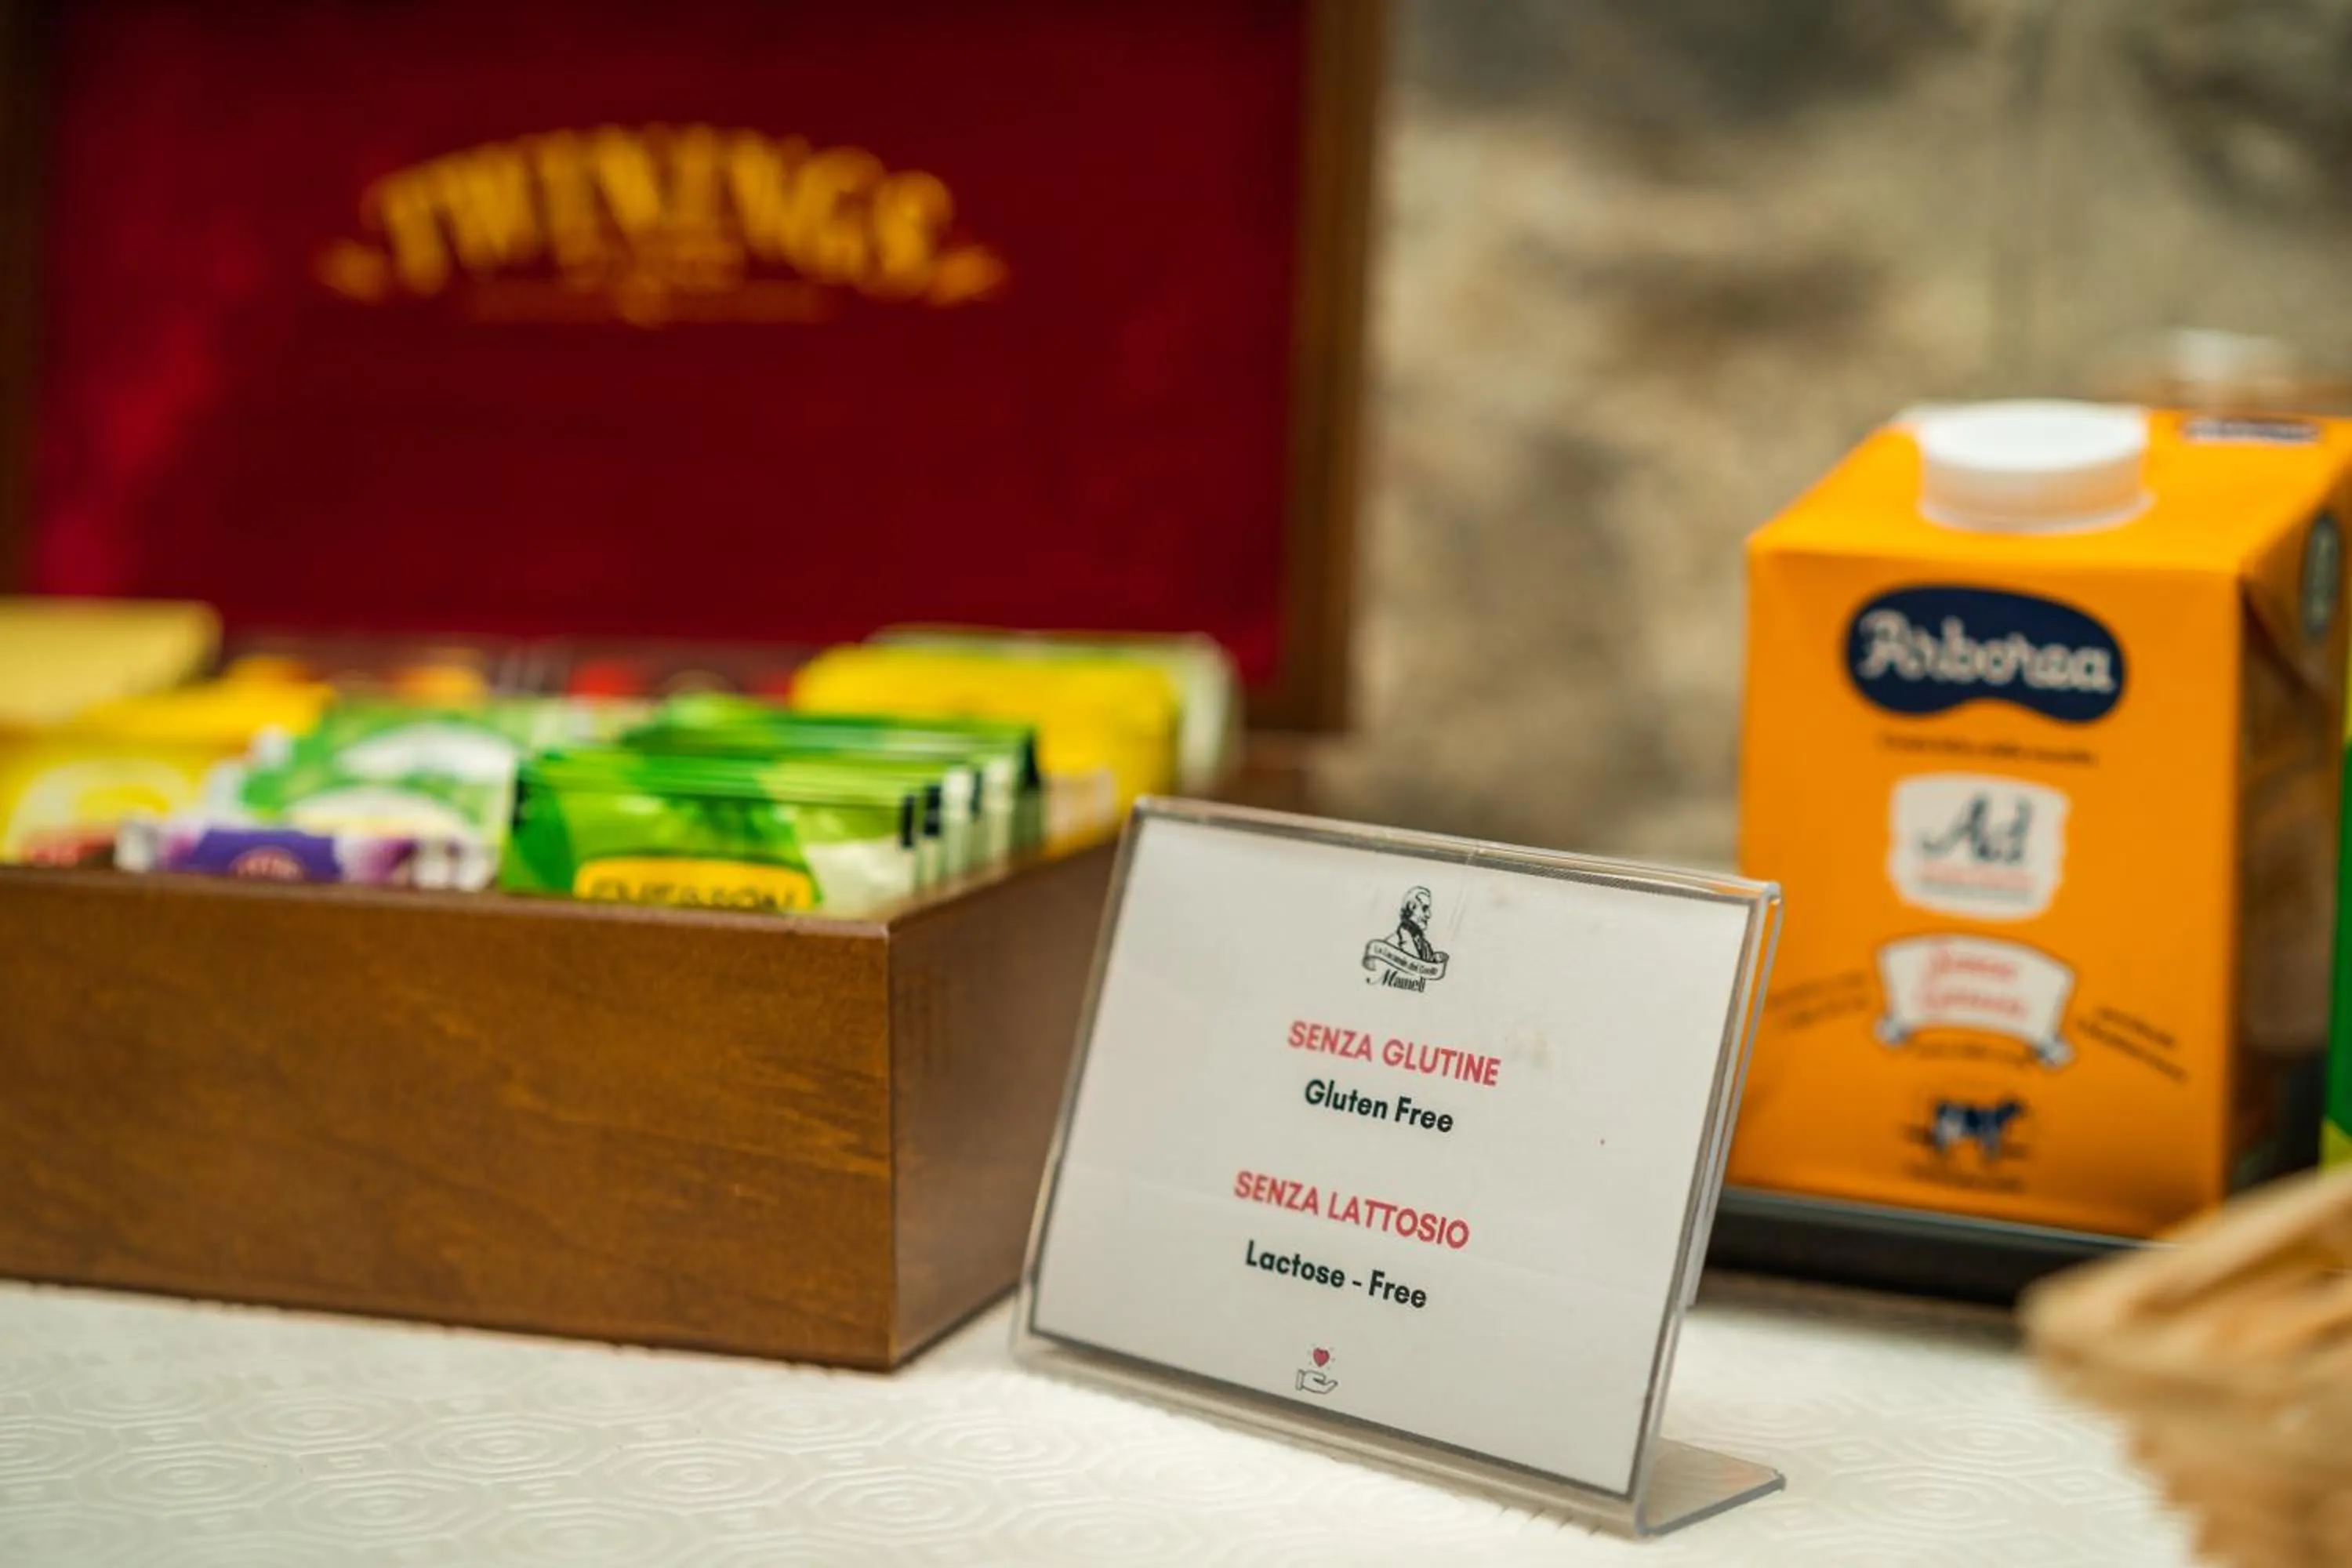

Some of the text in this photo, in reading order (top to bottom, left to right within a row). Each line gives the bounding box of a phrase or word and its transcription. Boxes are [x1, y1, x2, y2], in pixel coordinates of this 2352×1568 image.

[361, 122, 953, 301] TWININGS
[1858, 608, 2115, 692] Arborea
[1288, 1021, 1501, 1087] SENZA GLUTINE
[1305, 1079, 1454, 1133] Gluten Free
[1234, 1171, 1470, 1250] SENZA LATTOSIO
[1245, 1240, 1346, 1288] Lactose
[1368, 1269, 1427, 1308] Free
